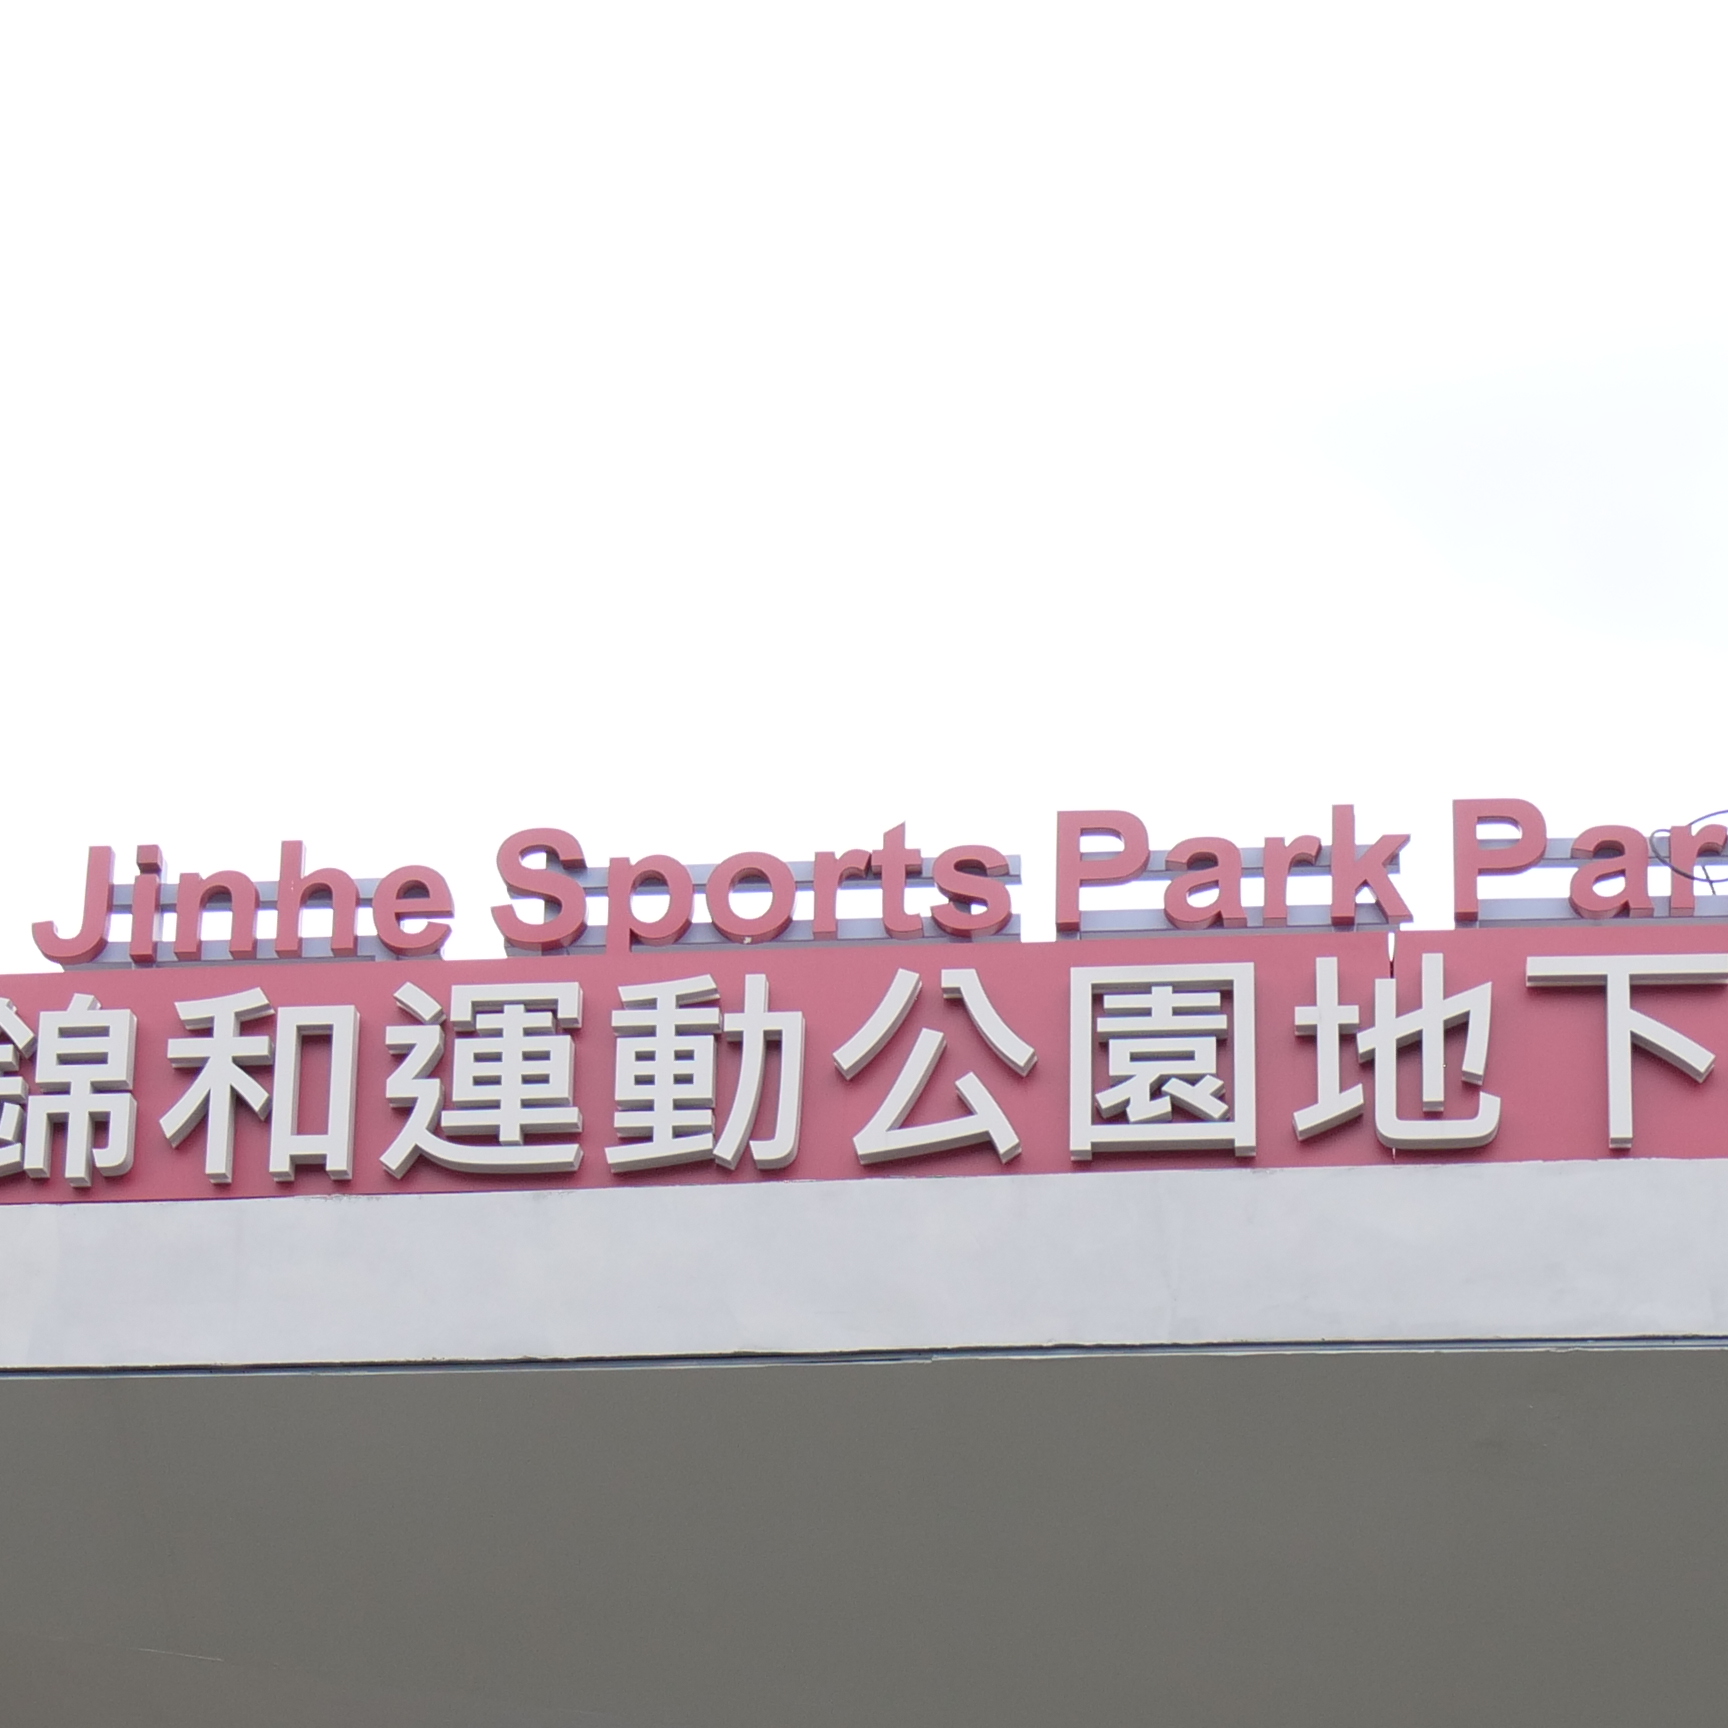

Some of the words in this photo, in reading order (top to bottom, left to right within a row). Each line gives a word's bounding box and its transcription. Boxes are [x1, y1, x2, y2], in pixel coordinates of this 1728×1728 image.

[30, 838, 455, 966] Jinhe
[489, 820, 1014, 957] Sports
[1054, 806, 1412, 930] Park
